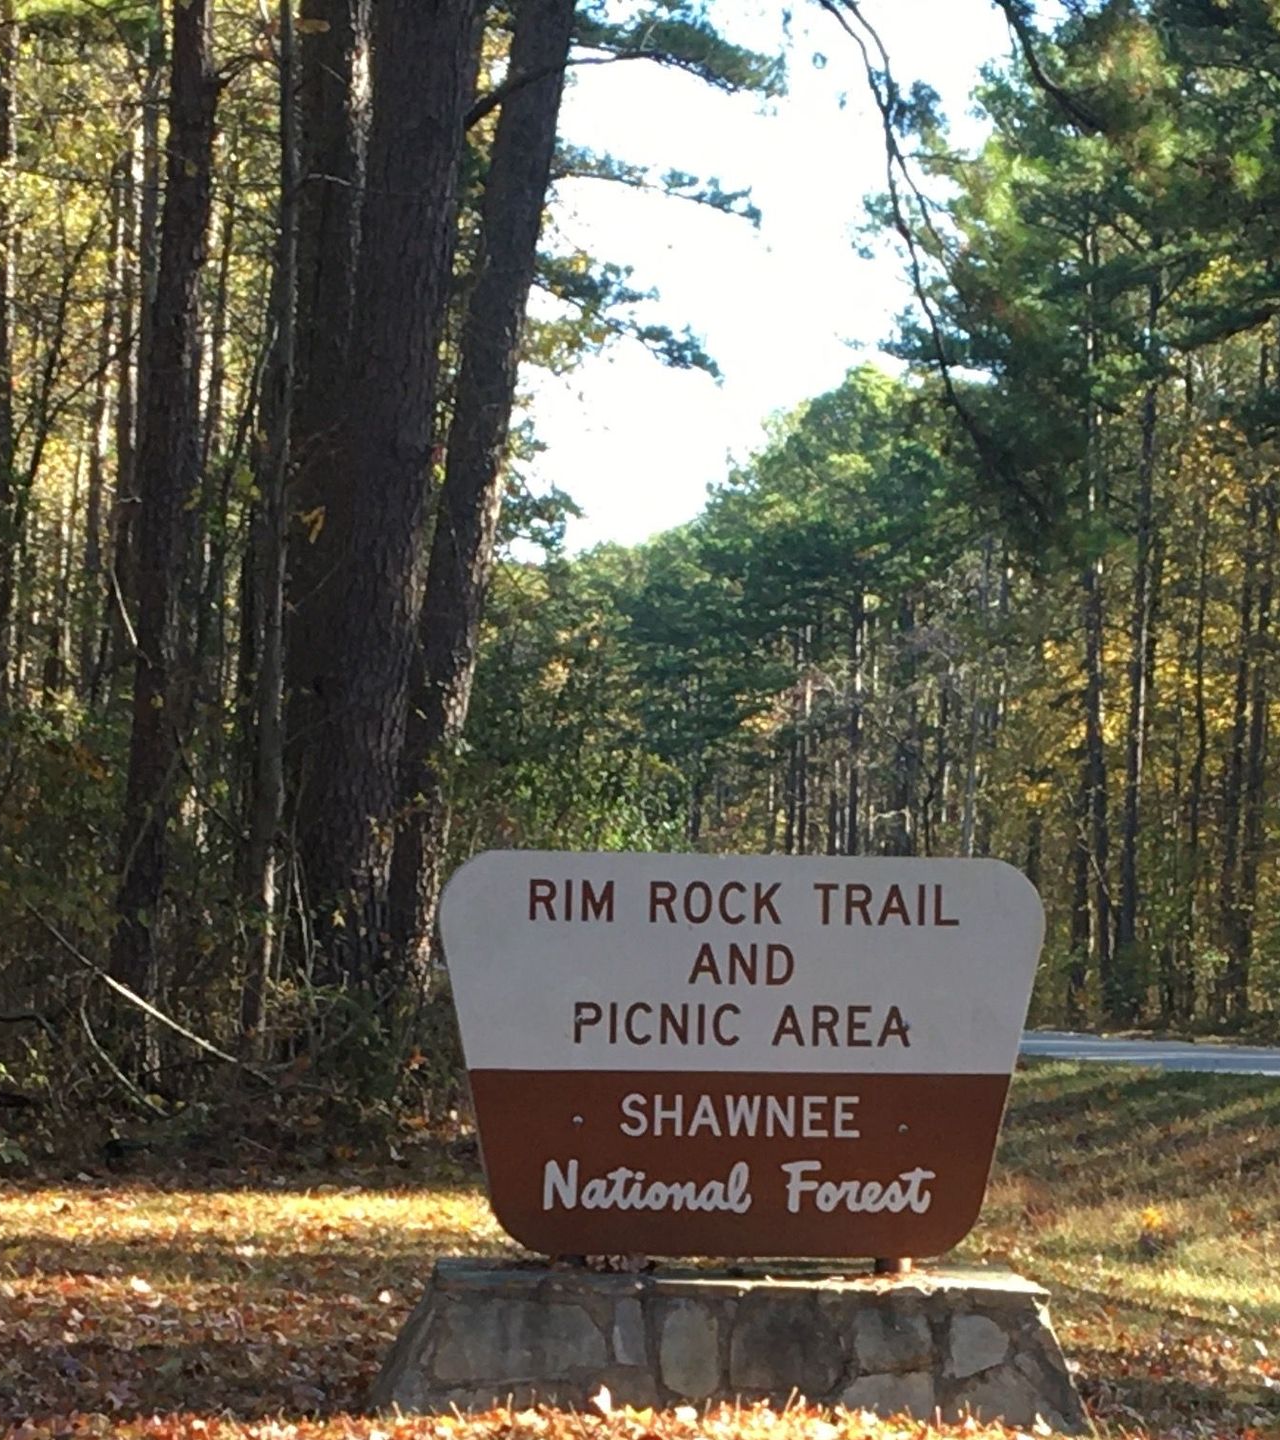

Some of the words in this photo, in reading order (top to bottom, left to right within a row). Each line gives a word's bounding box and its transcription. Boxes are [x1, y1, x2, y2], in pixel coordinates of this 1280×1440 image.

[528, 878, 615, 923] RIM
[649, 880, 782, 926] ROCK
[814, 882, 960, 927] TRAIL
[688, 943, 795, 986] AND
[573, 1001, 741, 1046] PICNIC
[771, 1005, 912, 1048] AREA
[620, 1093, 861, 1139] SHAWNEE
[542, 1159, 753, 1215] National
[780, 1160, 936, 1215] Forest
